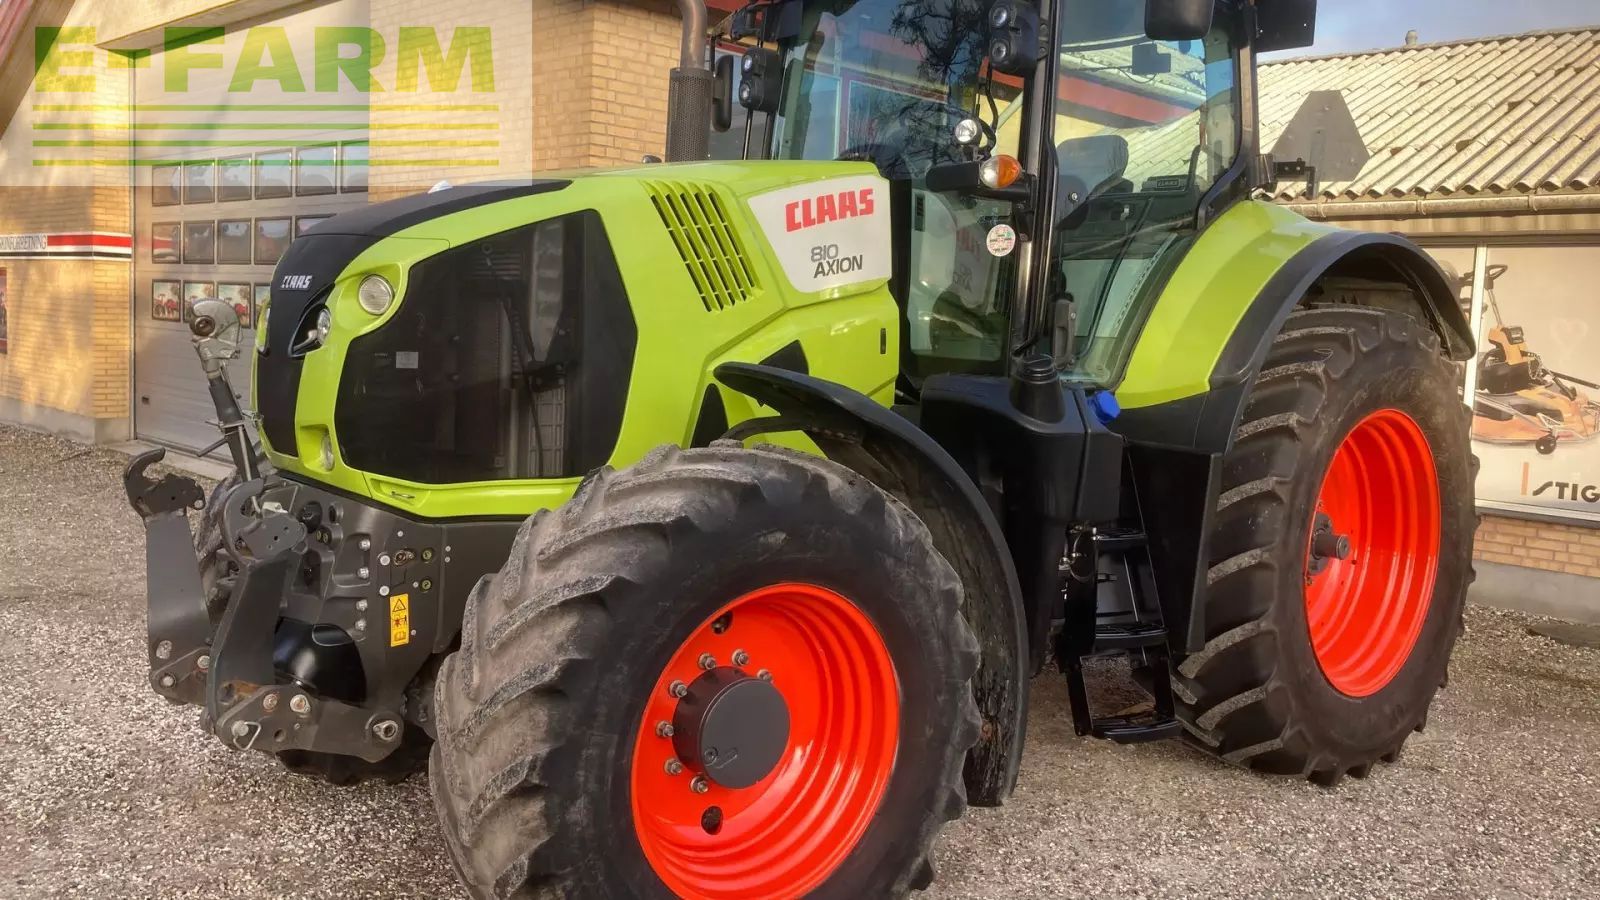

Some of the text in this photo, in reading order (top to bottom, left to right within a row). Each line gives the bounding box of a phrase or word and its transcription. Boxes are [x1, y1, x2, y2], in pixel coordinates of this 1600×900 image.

[785, 188, 874, 232] CLAAS
[811, 244, 839, 262] 810
[814, 254, 863, 279] AXION
[281, 275, 313, 289] CLAAS
